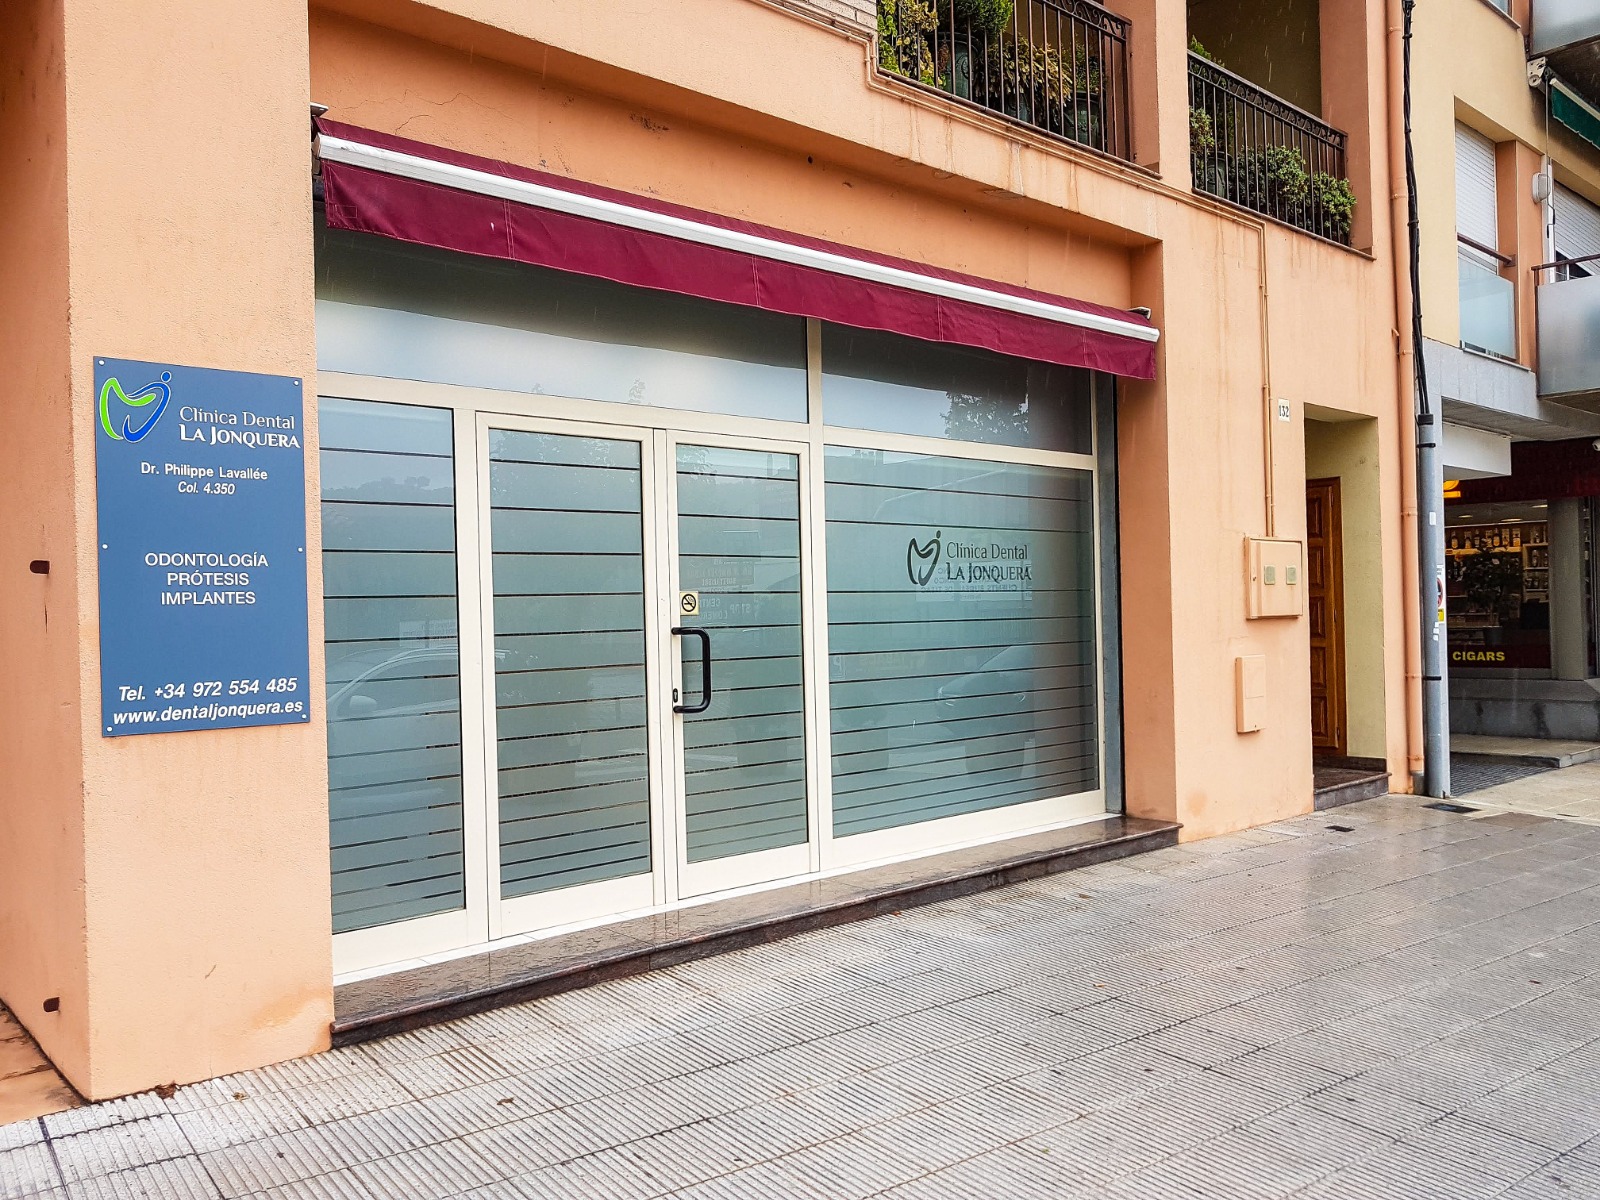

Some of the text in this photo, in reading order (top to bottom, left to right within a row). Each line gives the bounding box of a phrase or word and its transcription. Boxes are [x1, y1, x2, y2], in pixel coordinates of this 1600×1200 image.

[179, 406, 295, 429] Clínica Dental
[1279, 405, 1289, 417] 132
[179, 424, 301, 448] LA JONQUERA
[141, 462, 268, 480] Dr. Philippe Lavallée
[178, 481, 236, 495] Col. 4.350
[145, 552, 269, 567] ODONTOLOGÍA
[946, 541, 1028, 560] Clínica Dental
[167, 570, 250, 586] PRÓTESIS
[946, 562, 965, 580] LA
[967, 562, 1032, 584] JONQUERA
[161, 591, 256, 605] IMPLANTES
[1452, 651, 1506, 661] CIGARS
[118, 677, 298, 701] Tel. +34 972 554 485
[113, 700, 304, 725] www.dentaljonquera.es
